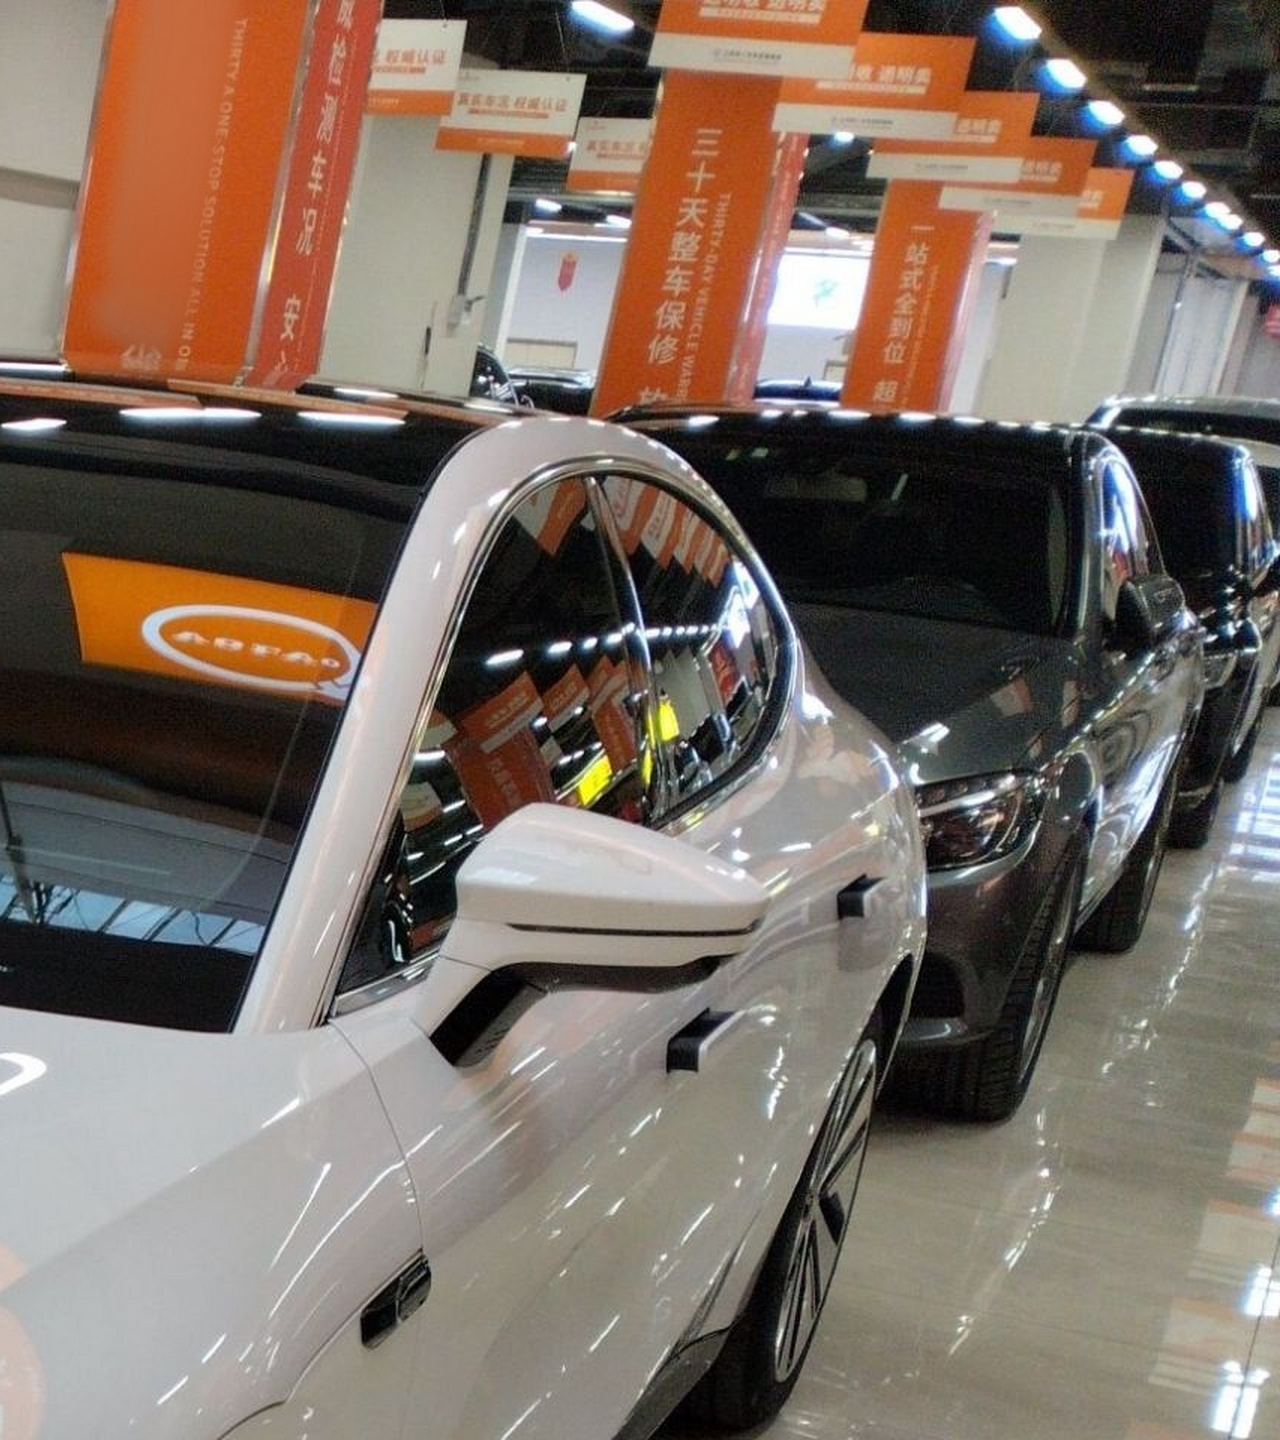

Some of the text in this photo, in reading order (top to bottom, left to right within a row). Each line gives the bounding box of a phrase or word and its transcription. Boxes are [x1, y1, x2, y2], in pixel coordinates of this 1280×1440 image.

[647, 128, 724, 366] 三十天整车保修
